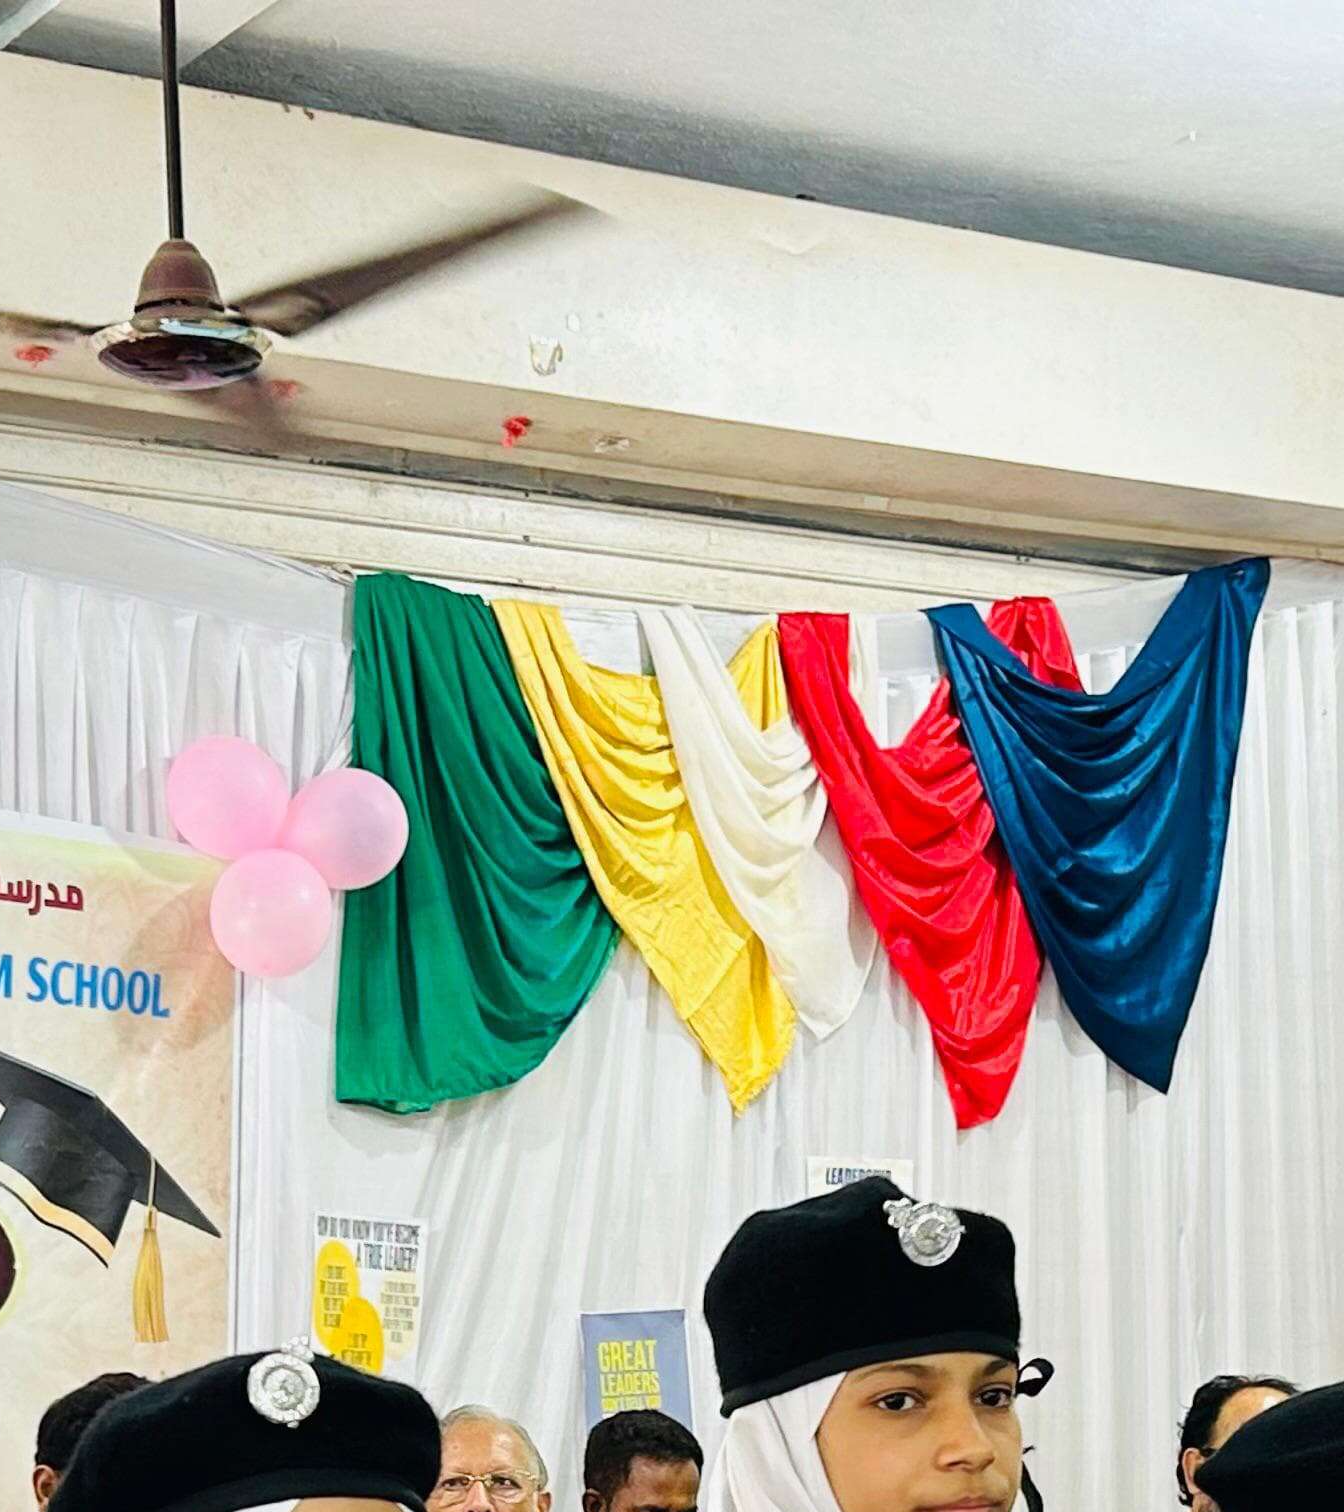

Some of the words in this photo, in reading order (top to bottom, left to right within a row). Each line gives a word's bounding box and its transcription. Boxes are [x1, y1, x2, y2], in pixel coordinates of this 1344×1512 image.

[26, 957, 170, 1018] SCHOOL
[598, 1339, 657, 1373] GREAT
[600, 1371, 661, 1397] LEADERS
